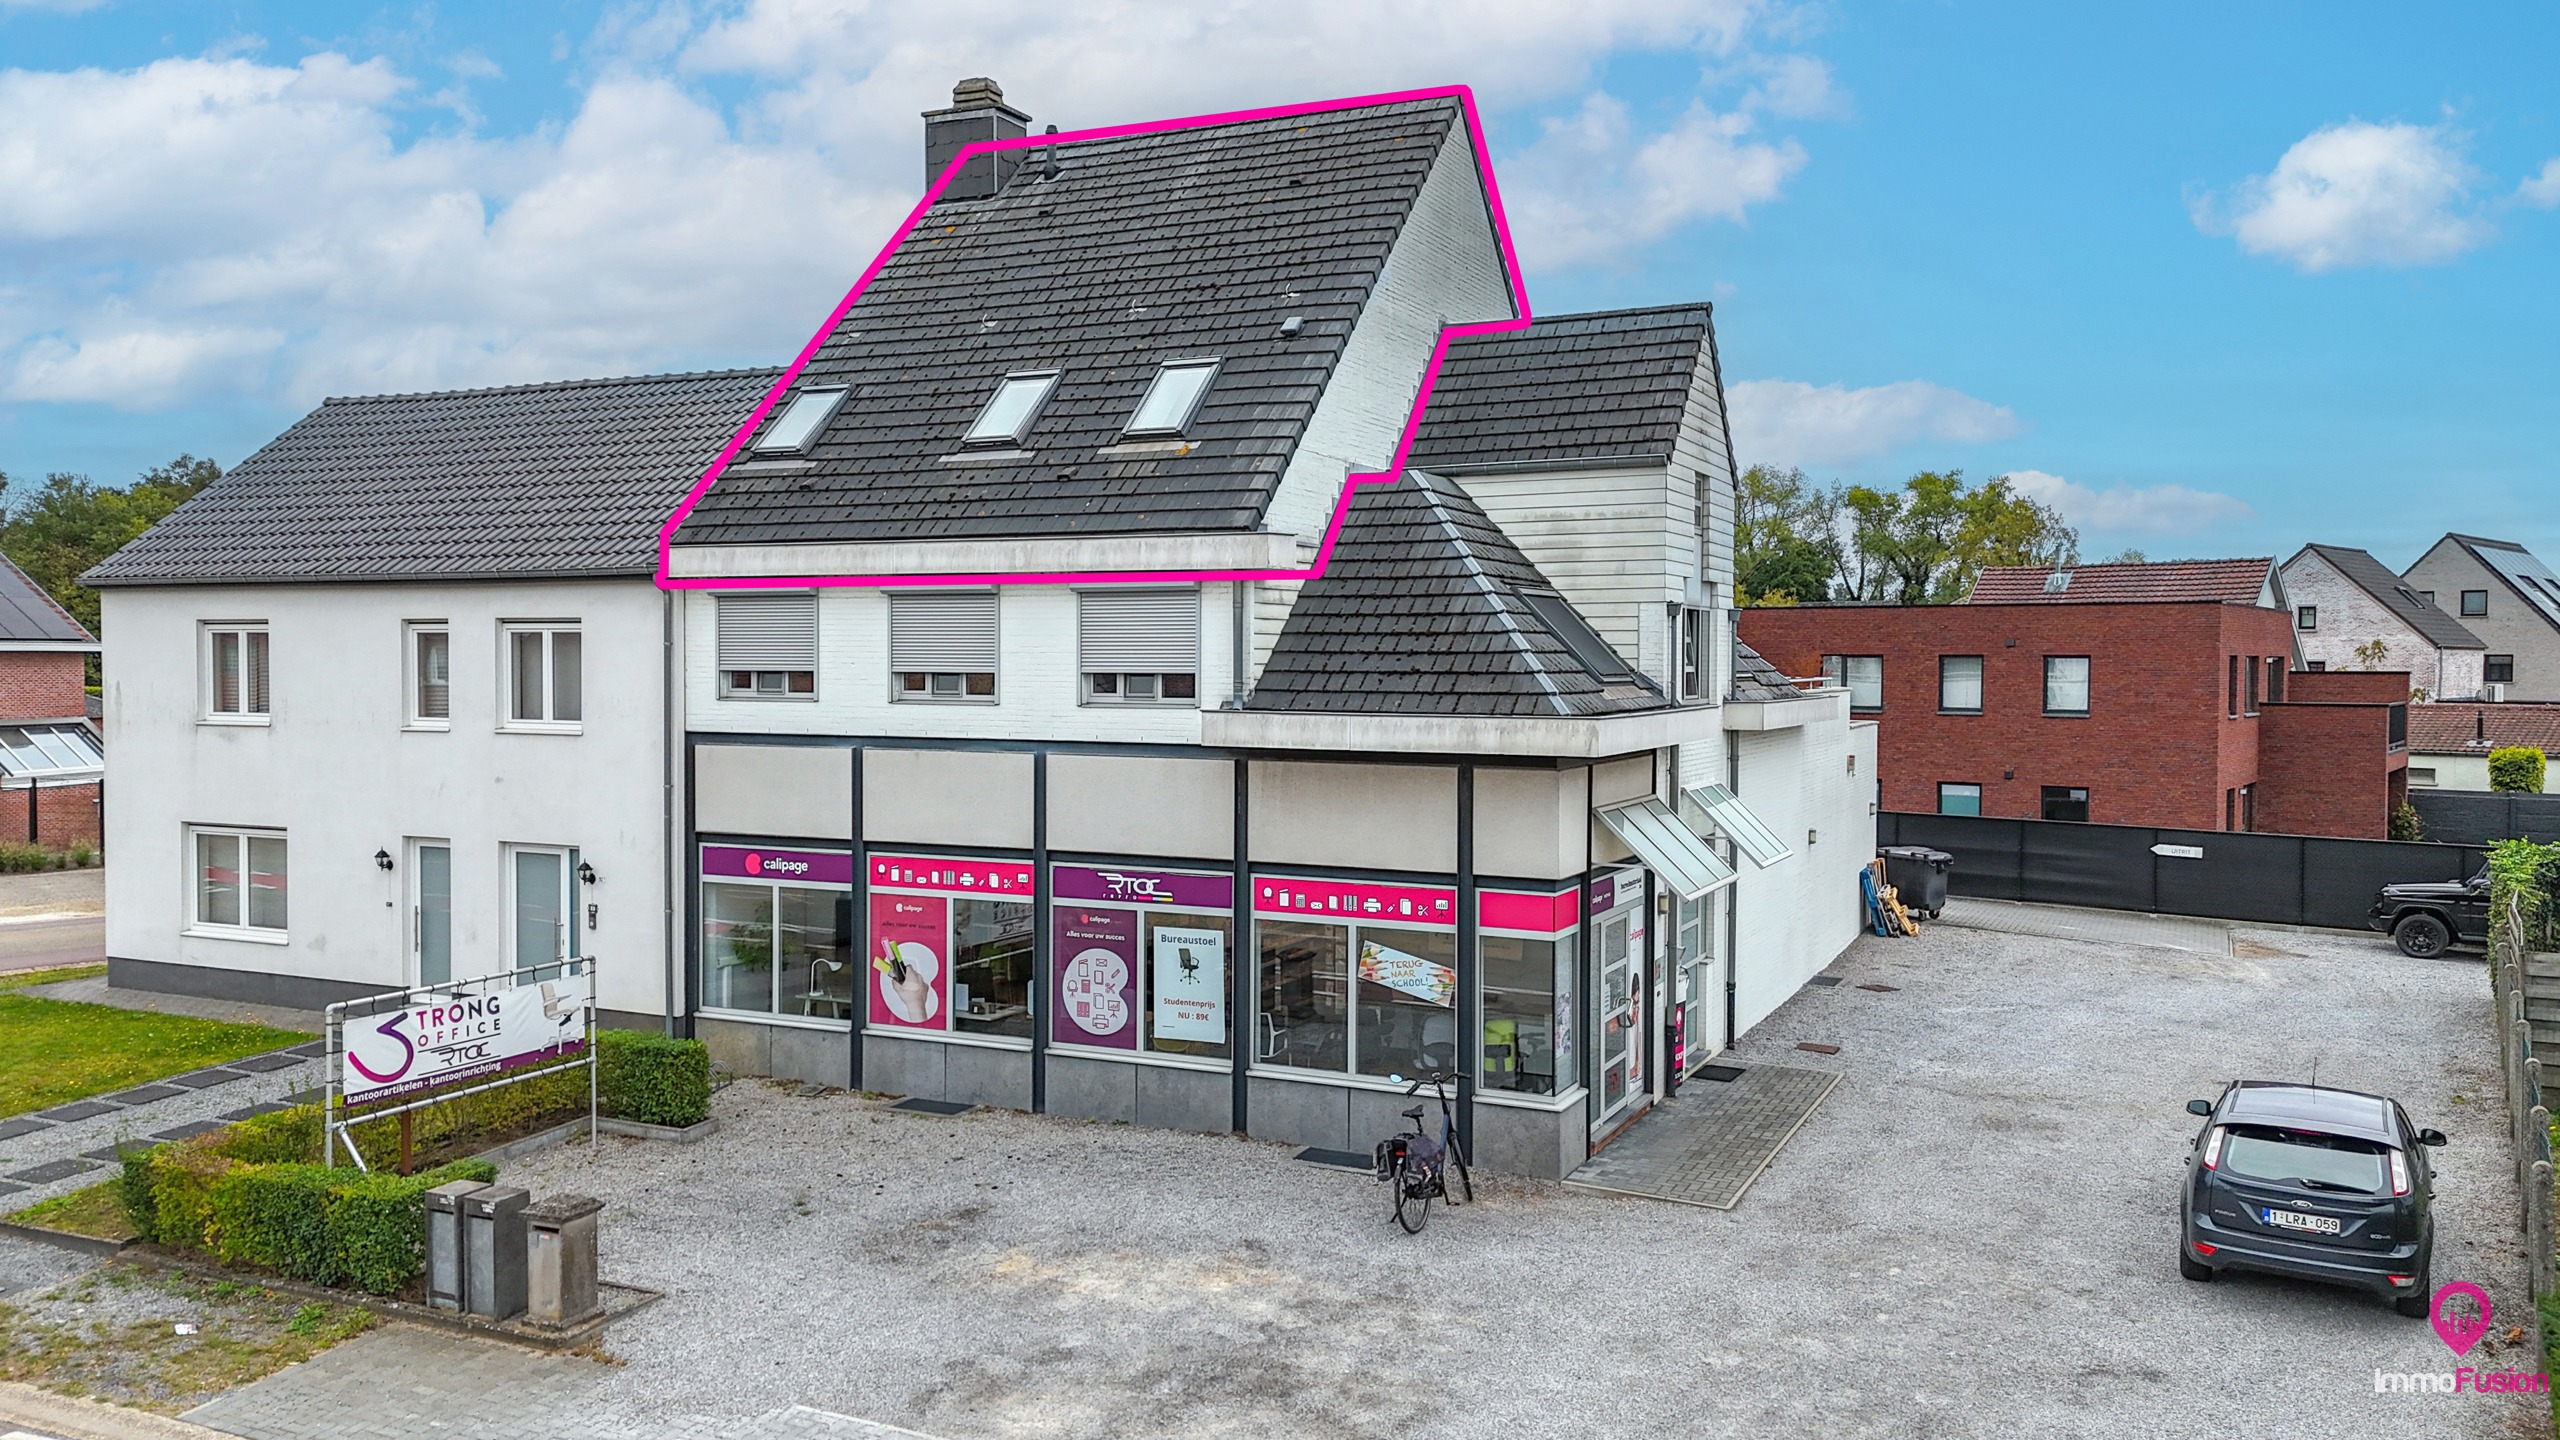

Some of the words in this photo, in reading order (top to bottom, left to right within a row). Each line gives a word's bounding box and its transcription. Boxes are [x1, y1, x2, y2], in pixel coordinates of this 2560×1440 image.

[763, 857, 809, 875] calipage
[1089, 915, 1111, 924] calipage
[1066, 930, 1080, 938] Alles
[1160, 934, 1217, 947] Bureaustoel
[1389, 959, 1424, 969] TERUG
[1390, 969, 1417, 978] NAAR
[1391, 976, 1430, 988] SCHOOL!
[1163, 997, 1216, 1010] Studentenprijs
[1177, 1011, 1190, 1020] NU
[417, 1018, 501, 1047] OFFICE
[346, 1080, 423, 1105] kantoorartikelen
[429, 1061, 502, 1086] kantoorinrichting
